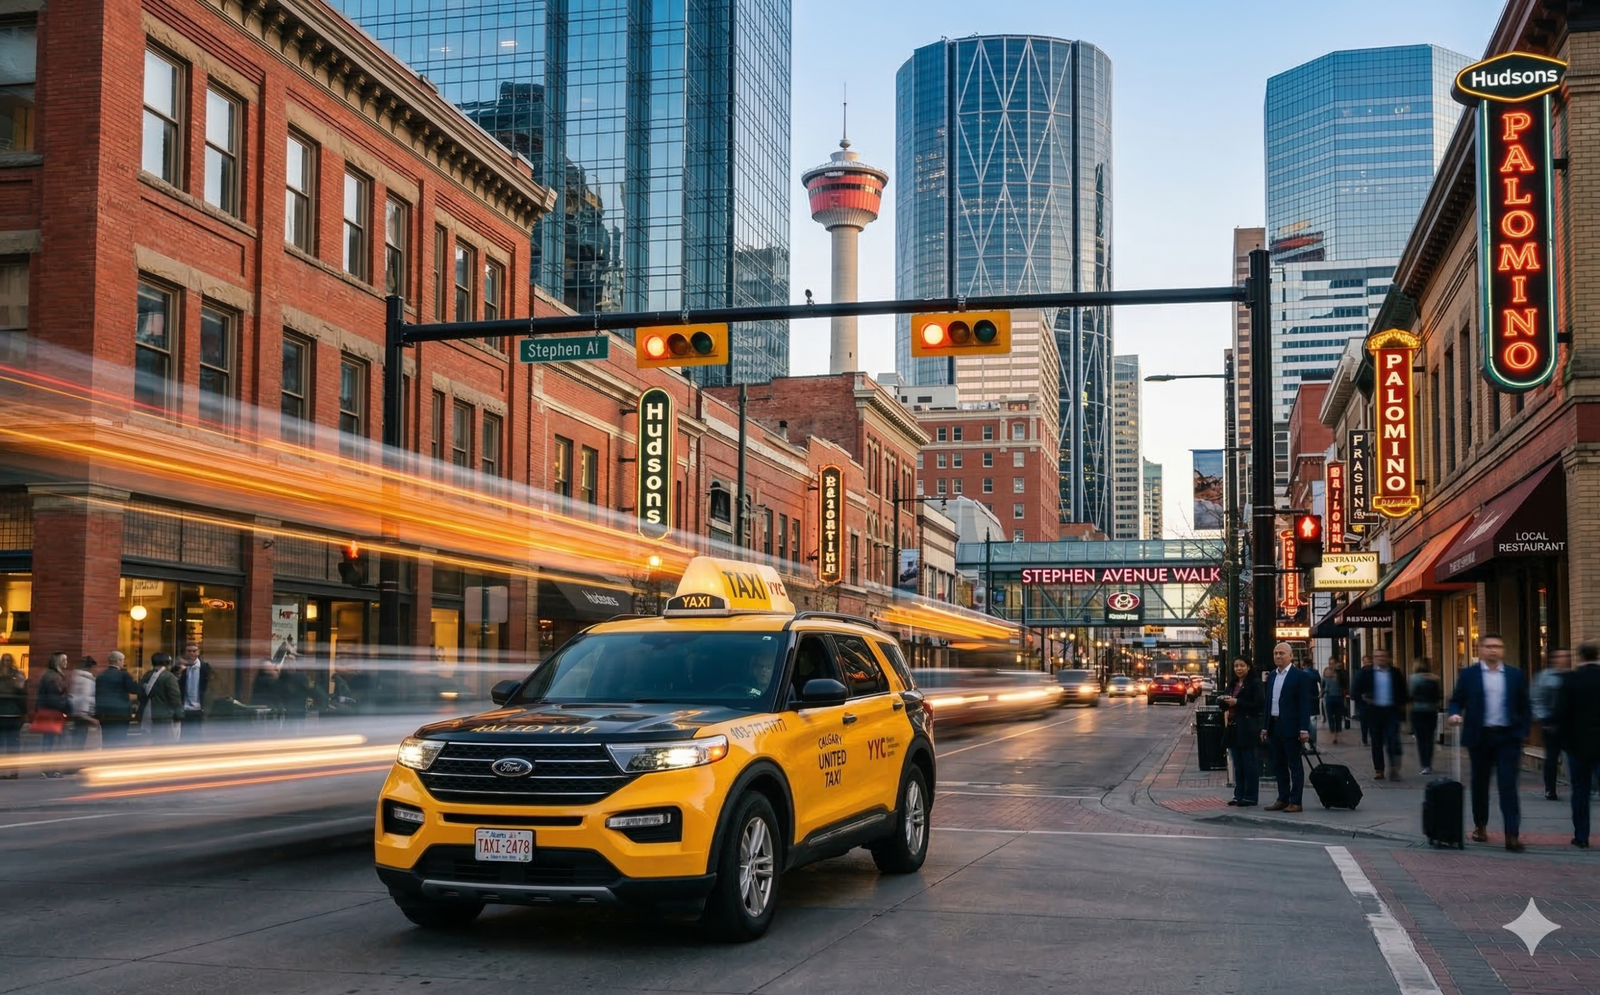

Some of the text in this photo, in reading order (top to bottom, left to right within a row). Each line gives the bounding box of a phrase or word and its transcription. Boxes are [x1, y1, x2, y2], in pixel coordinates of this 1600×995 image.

[1471, 67, 1558, 88] Hudsons
[1498, 112, 1541, 369] PALOMINO
[527, 343, 581, 360] Stephen
[1384, 354, 1407, 491] PALOMINO
[646, 403, 663, 524] Hudsons
[1515, 532, 1549, 541] LOCAL
[1498, 542, 1566, 552] RESTAURANT
[1022, 567, 1221, 583] STEPHEN AVENUE WALK
[721, 571, 786, 600] TAXI YYC
[681, 596, 711, 608] YAXI
[818, 733, 842, 750] CALGARY
[867, 737, 887, 761] YYC
[500, 761, 521, 772] Ford
[818, 749, 847, 770] UNITED
[825, 769, 842, 788] TAXI
